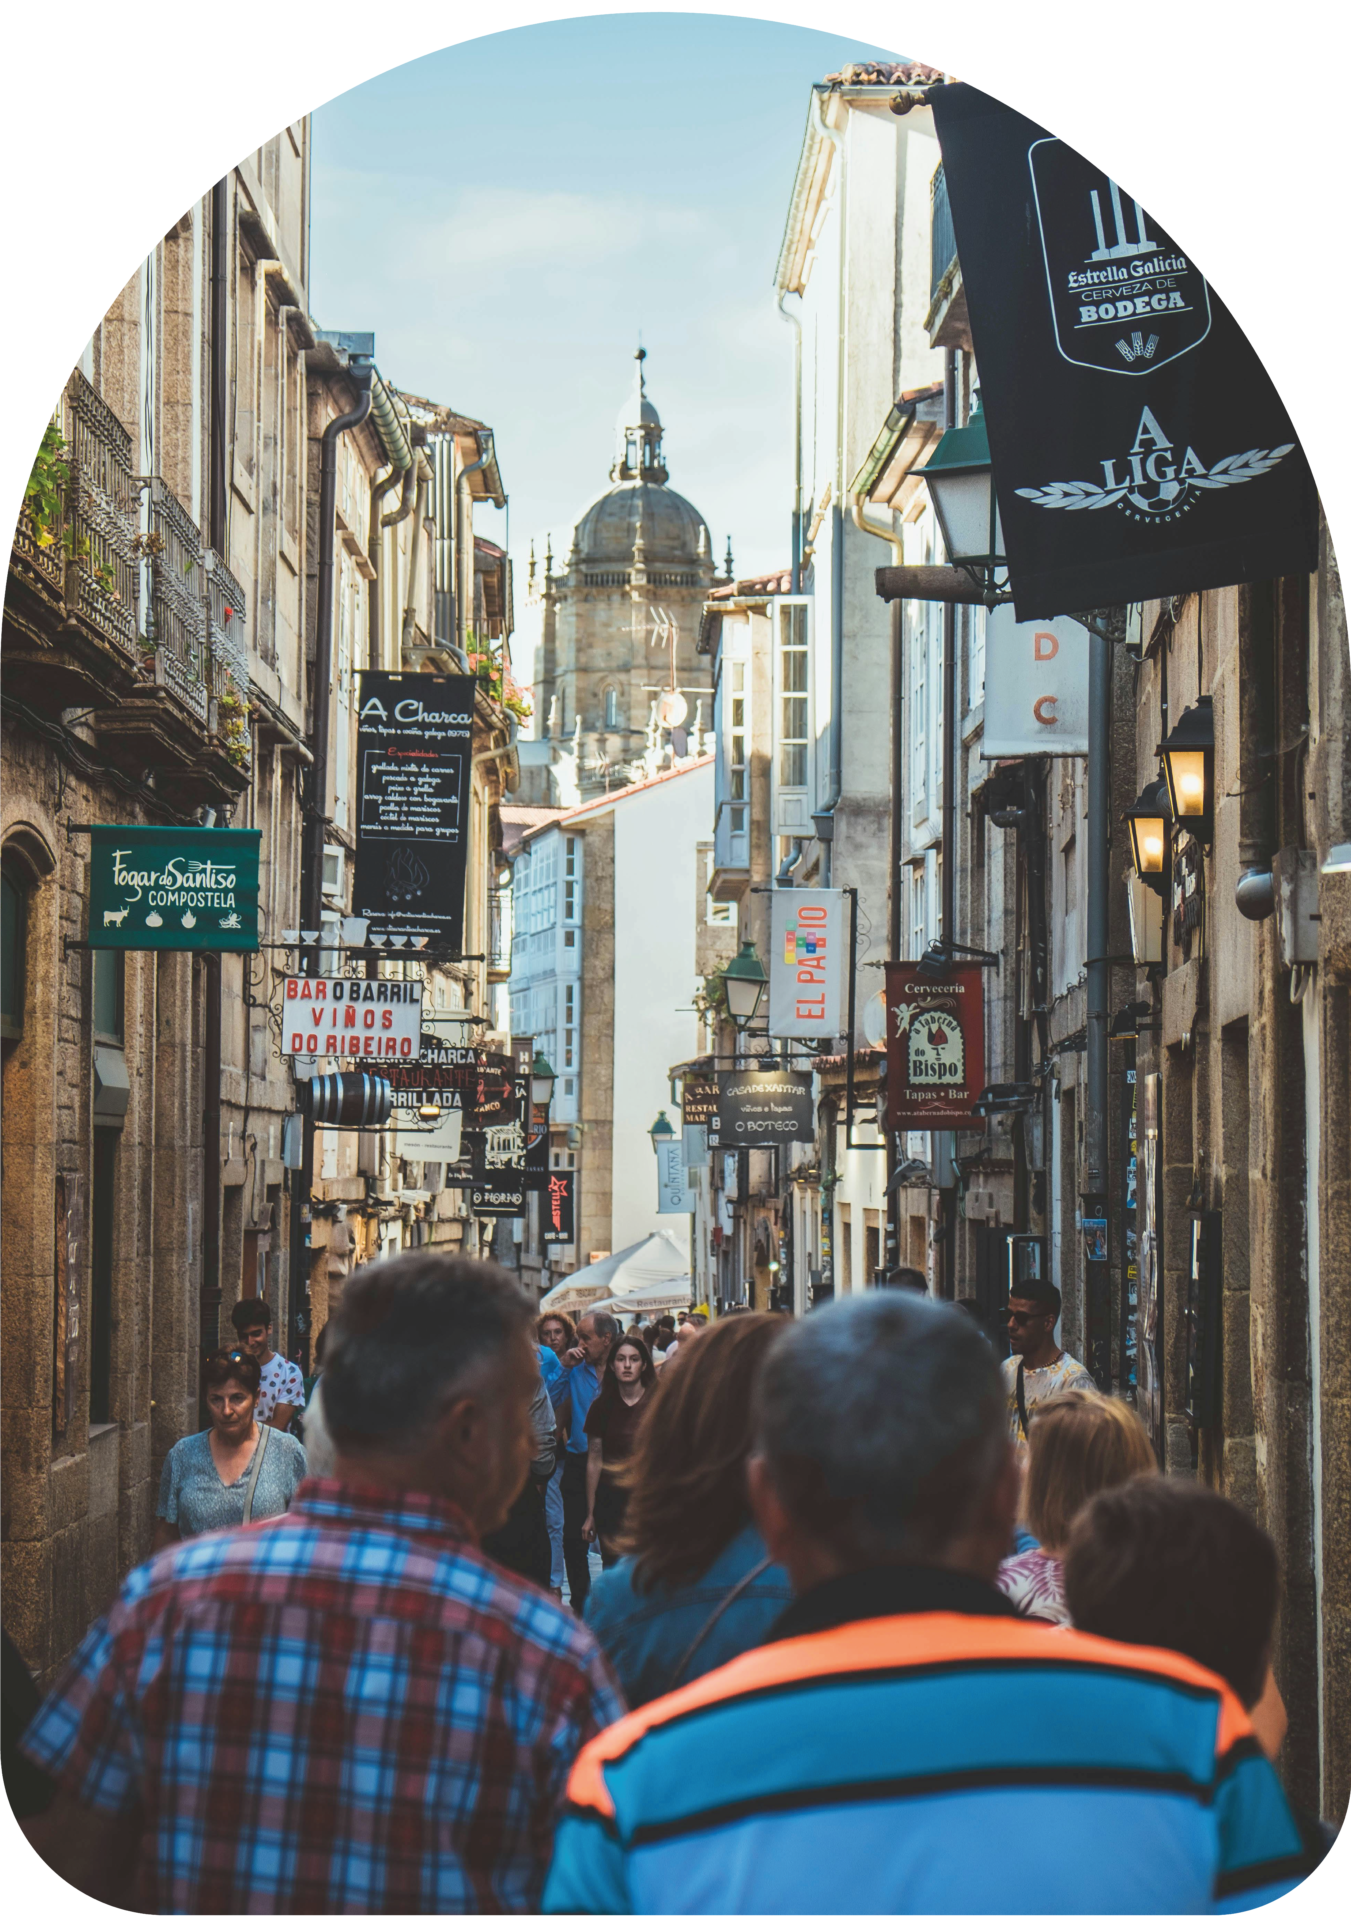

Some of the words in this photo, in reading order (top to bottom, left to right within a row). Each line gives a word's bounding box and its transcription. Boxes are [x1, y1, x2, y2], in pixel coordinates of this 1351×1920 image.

[1068, 265, 1128, 288] Estrella
[1130, 254, 1187, 277] Galicia
[1081, 282, 1153, 301] CERVEZA
[1156, 277, 1177, 289] DE
[1079, 291, 1185, 323] BODEGA
[1129, 405, 1174, 453] A
[1100, 446, 1208, 491] LIGA
[359, 697, 388, 721] A
[394, 699, 472, 724] Charca
[388, 747, 438, 759] Especialidades
[431, 766, 454, 774] carnes
[408, 814, 440, 822] mariscos
[410, 804, 442, 813] mariscos
[112, 849, 160, 902] Fogar
[159, 865, 173, 885] do
[165, 857, 236, 890] Santiso
[148, 891, 236, 908] COMPOSTELA
[286, 979, 327, 1001] BAR
[332, 981, 344, 1001] O
[349, 981, 420, 1003] BARRIL
[905, 983, 966, 994] Cervecería
[796, 992, 825, 1019] EL
[311, 1004, 393, 1029] VIÑOS
[919, 1014, 958, 1032] Taberna
[291, 1032, 318, 1053] DO
[326, 1034, 412, 1057] RIBEIRO
[914, 1047, 926, 1057] do
[420, 1049, 476, 1064] CHARCA
[912, 1059, 958, 1080] Bispo
[726, 1085, 752, 1097] CASA
[752, 1084, 764, 1093] DE
[765, 1083, 806, 1096] XANTAR
[904, 1089, 937, 1102] Tapas
[948, 1089, 970, 1099] Bar
[740, 1104, 763, 1113] viños
[770, 1102, 793, 1113] tapas
[735, 1121, 745, 1132] O
[747, 1120, 799, 1132] BOTECO
[667, 1147, 682, 1206] QUINTANA
